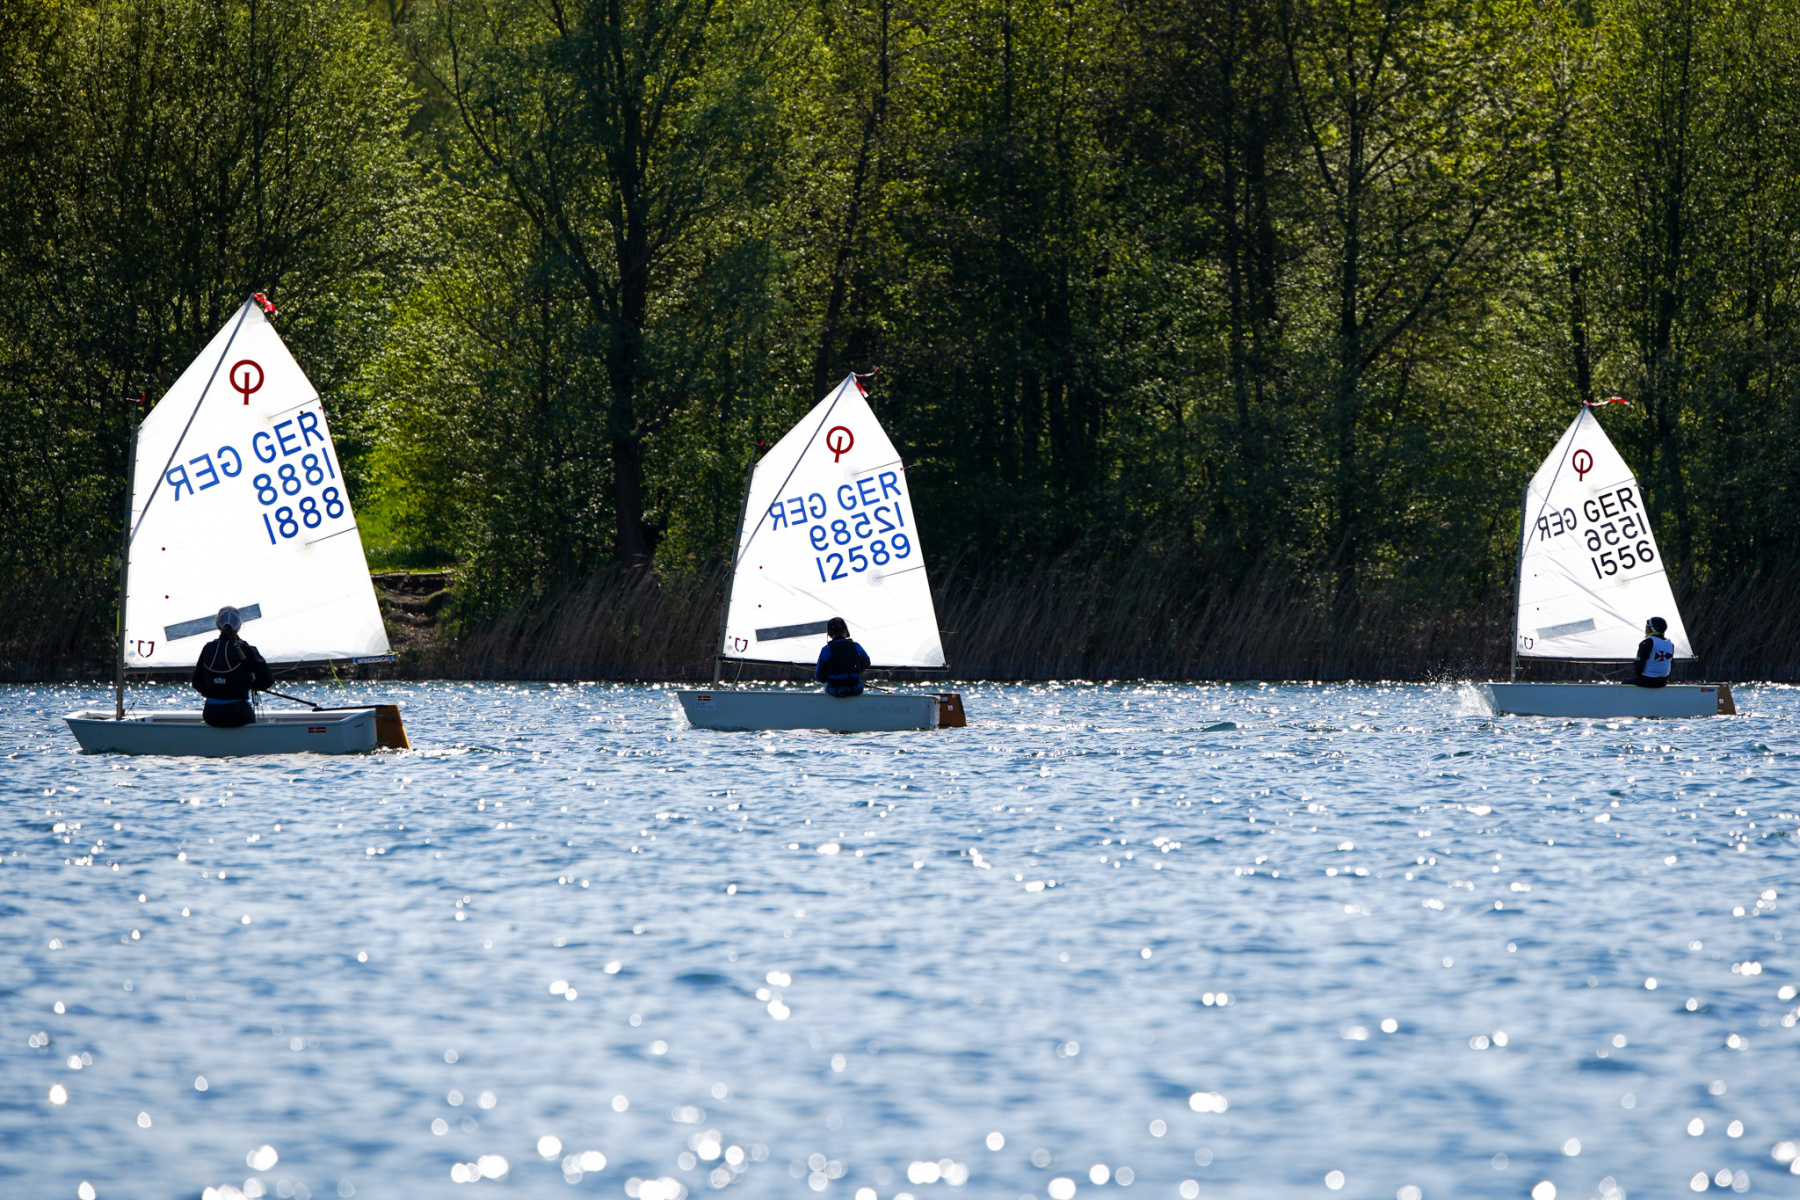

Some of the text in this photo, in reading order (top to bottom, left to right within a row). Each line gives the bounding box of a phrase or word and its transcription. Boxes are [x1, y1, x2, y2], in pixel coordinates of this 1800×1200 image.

[252, 411, 325, 464] GER
[836, 470, 902, 511] GER
[1583, 486, 1638, 523] GER
[262, 486, 345, 546] 1888
[815, 532, 911, 583] 12589
[1590, 539, 1655, 580] 1556
